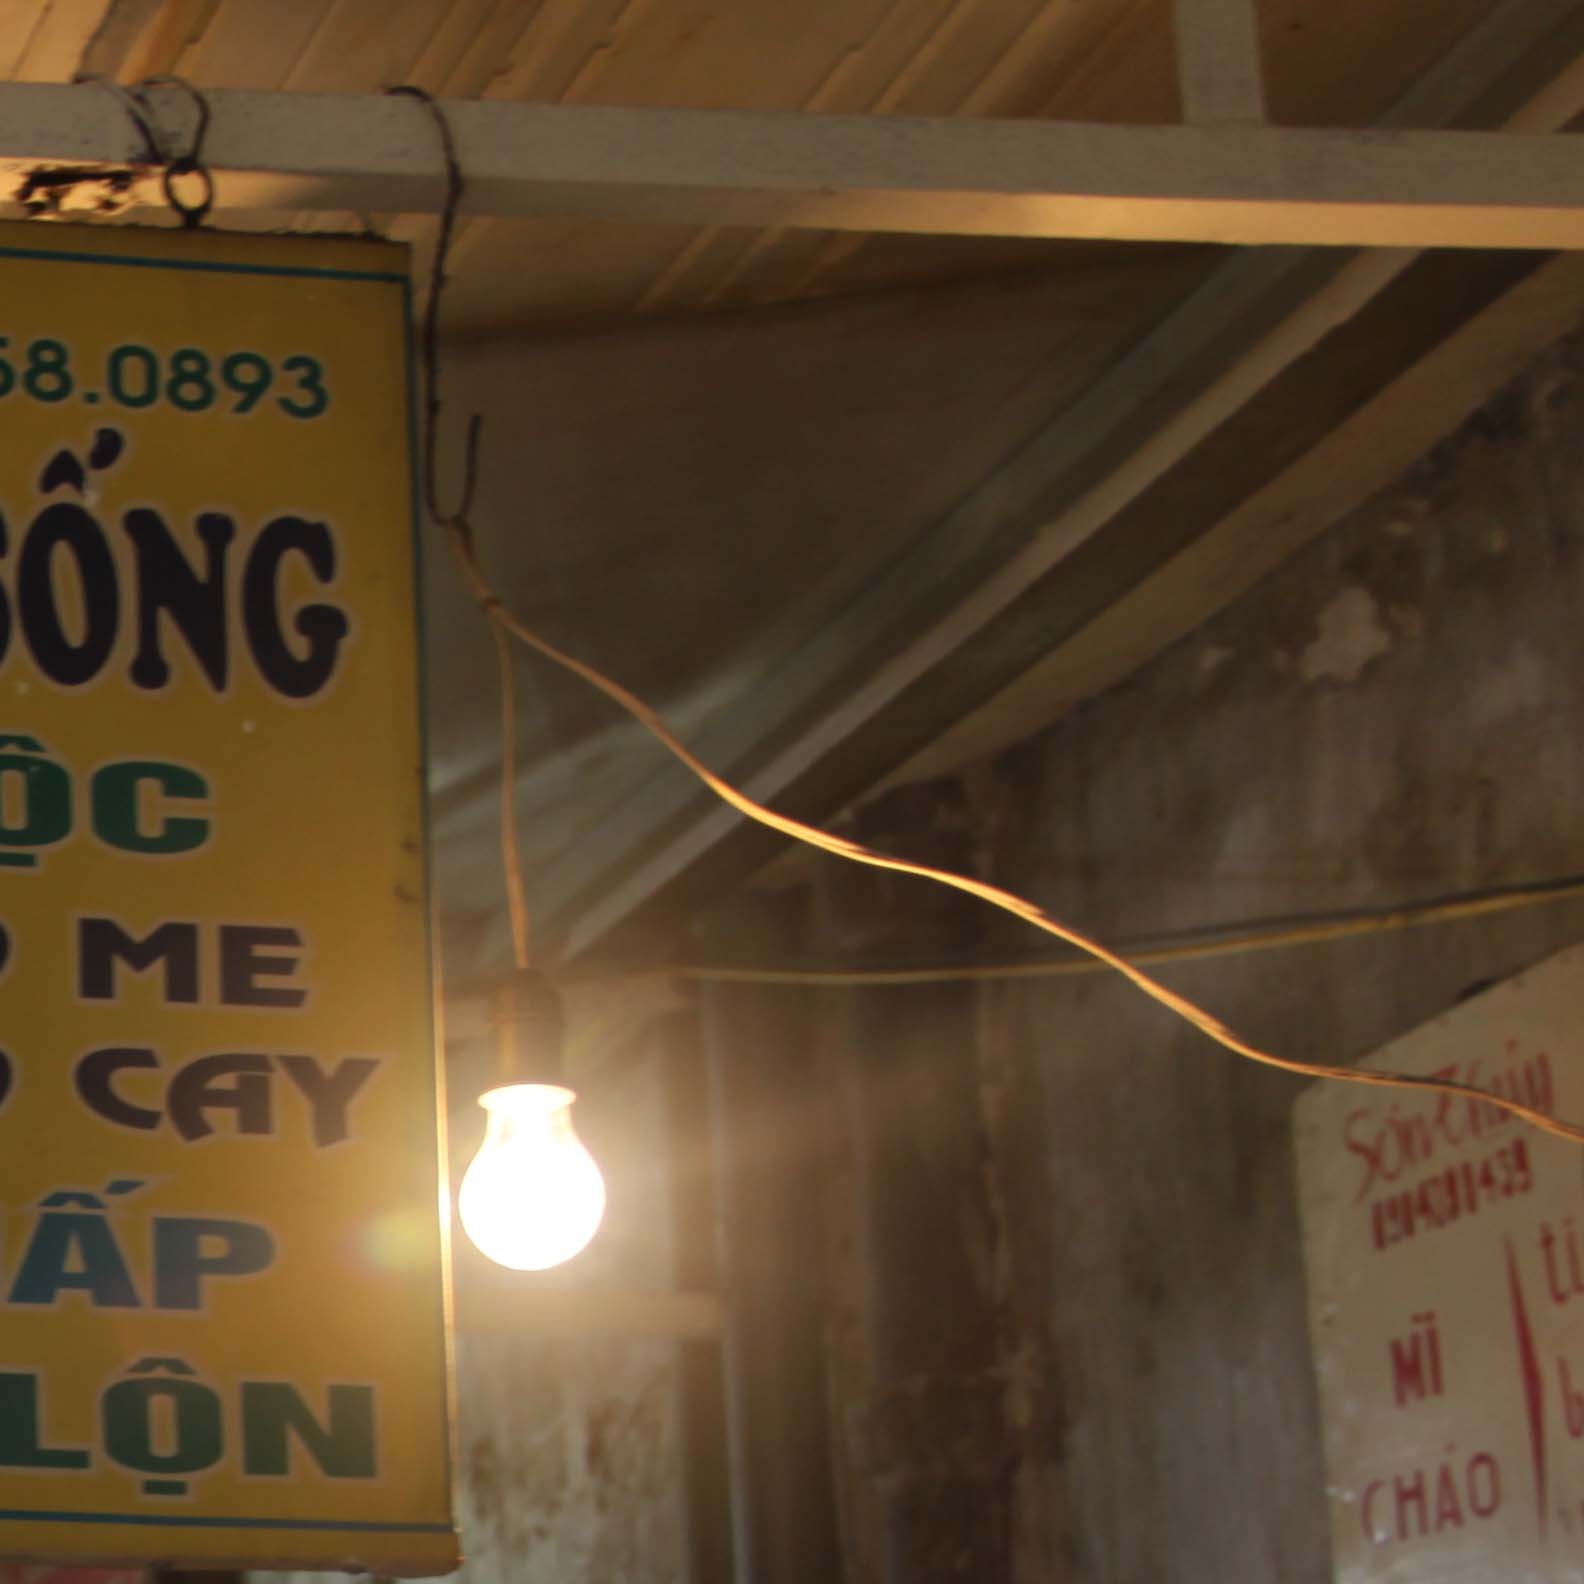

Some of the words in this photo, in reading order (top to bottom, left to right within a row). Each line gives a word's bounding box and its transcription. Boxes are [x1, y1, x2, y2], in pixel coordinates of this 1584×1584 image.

[78, 916, 308, 1008] ME
[74, 1046, 378, 1148] CAY
[1362, 1443, 1503, 1540] CHÁO
